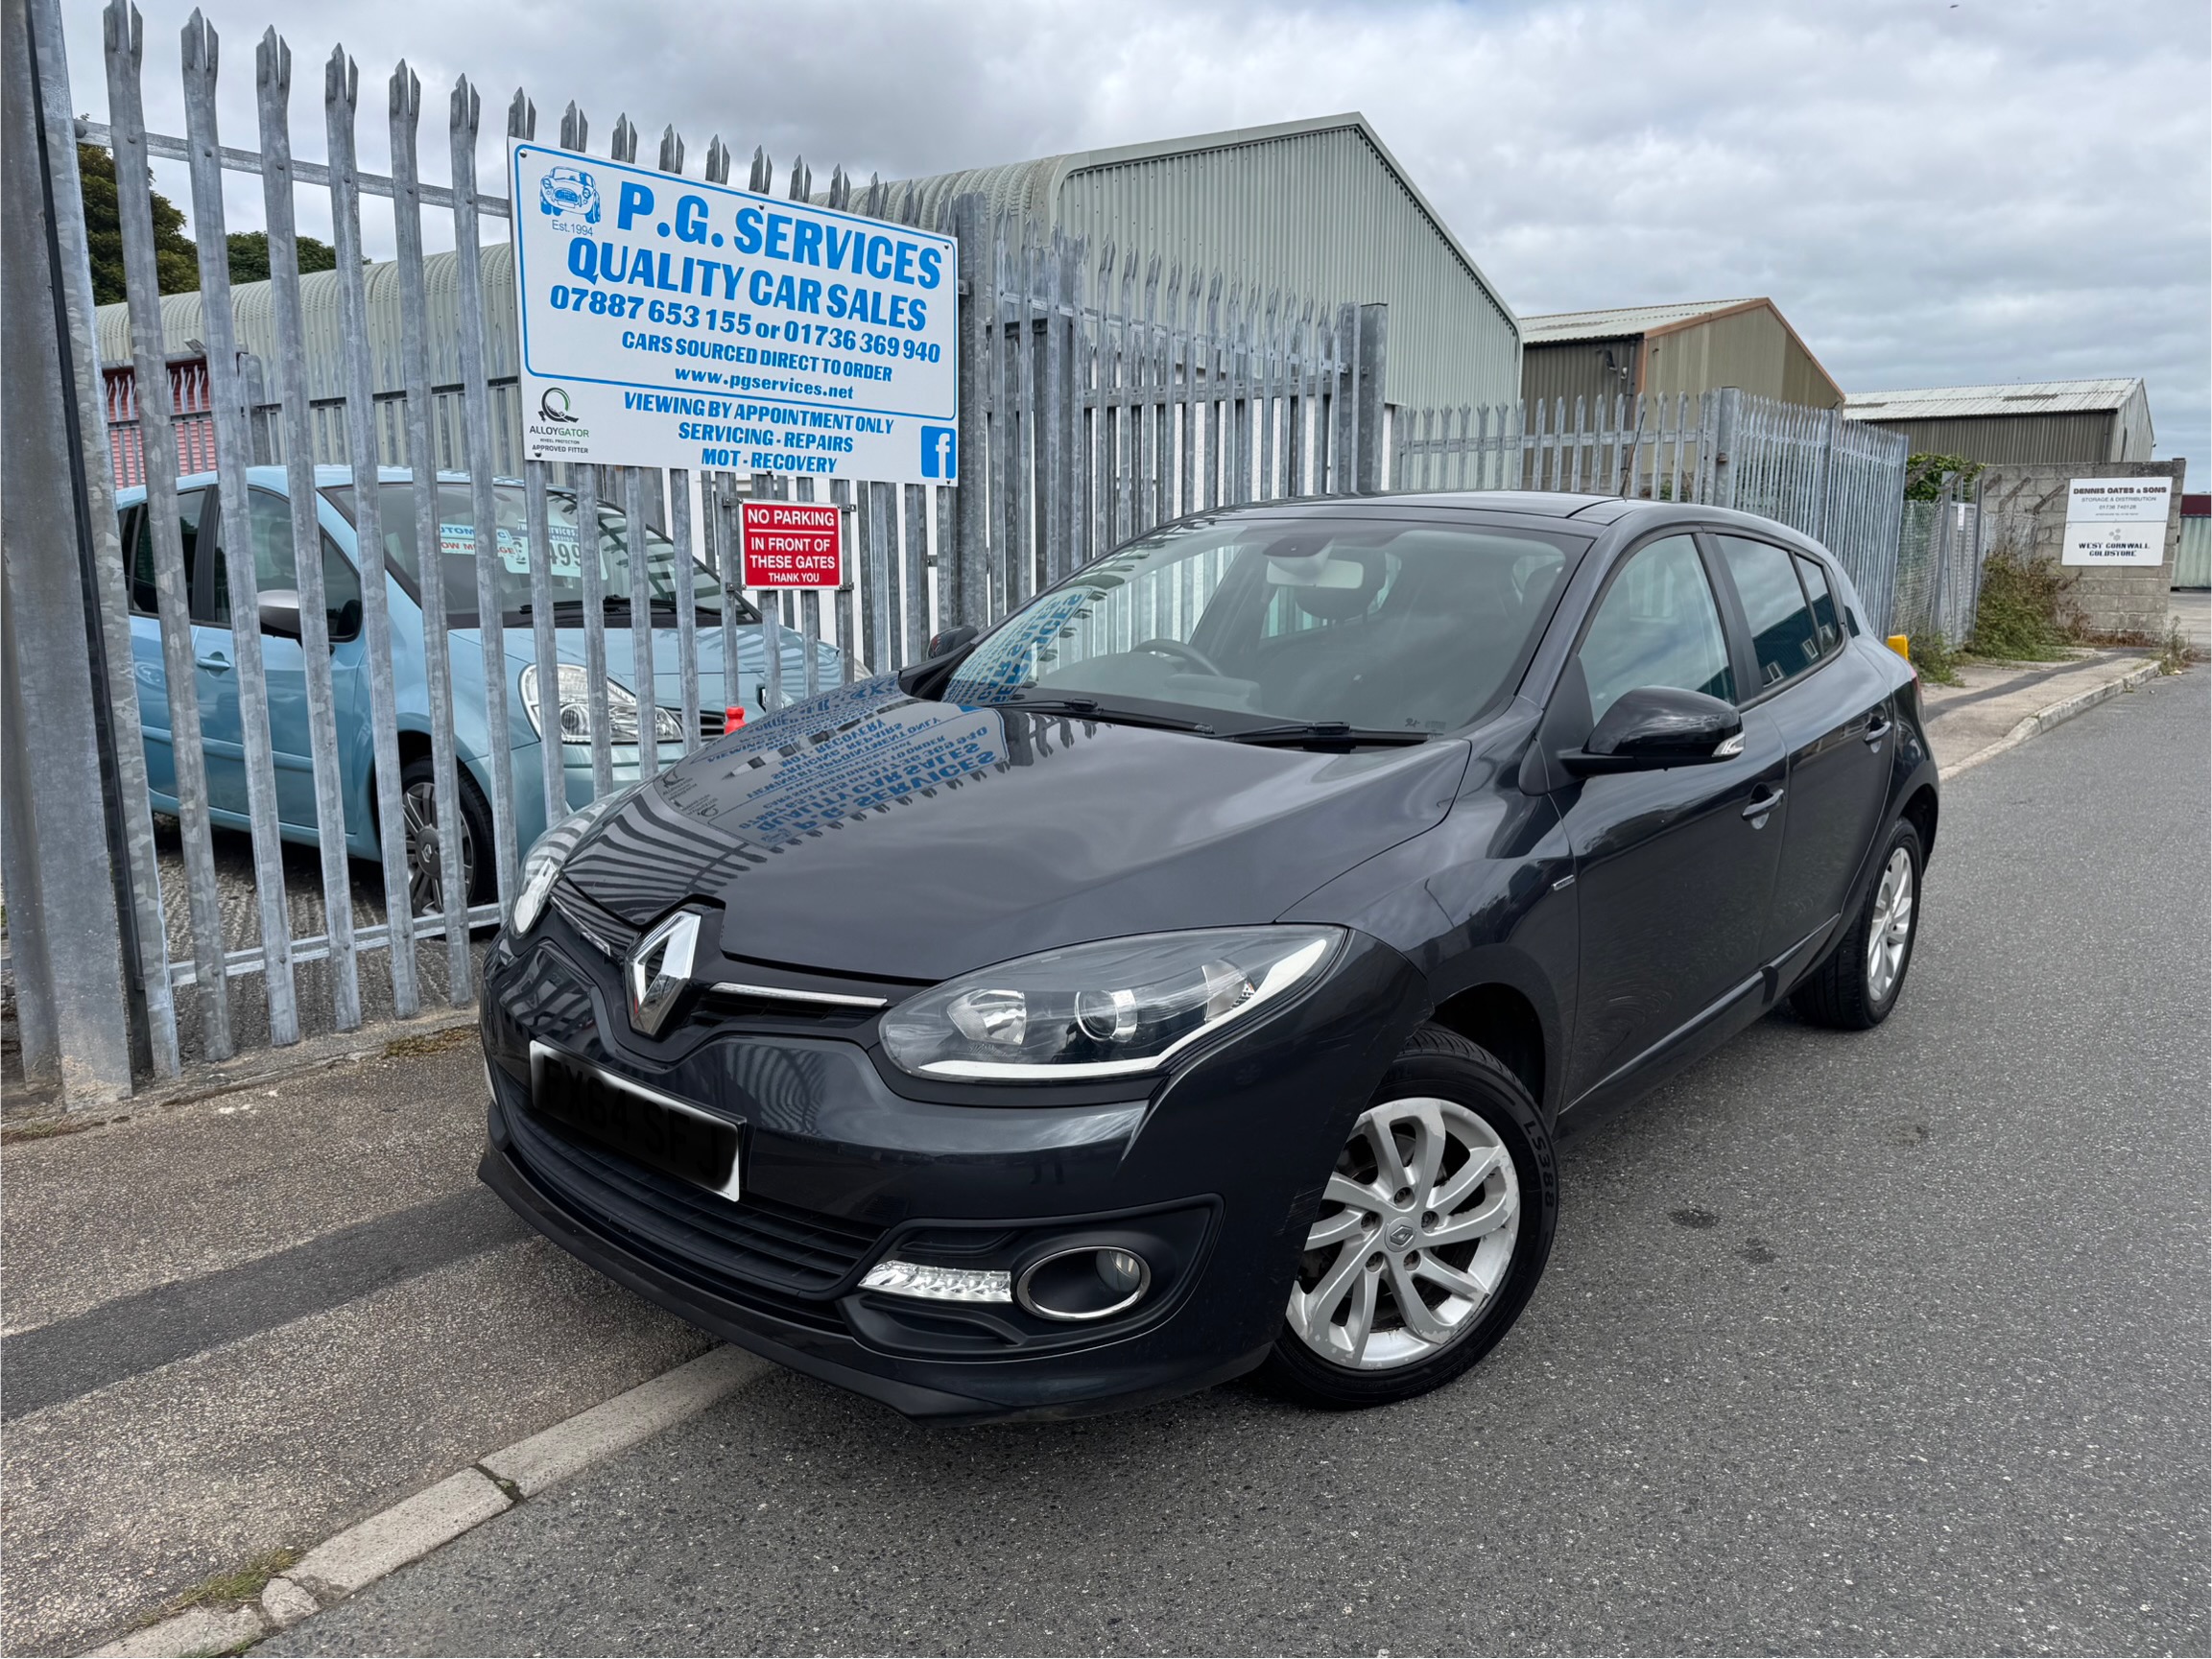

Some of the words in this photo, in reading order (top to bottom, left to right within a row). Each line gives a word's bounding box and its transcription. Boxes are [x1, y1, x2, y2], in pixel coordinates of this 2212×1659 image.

[552, 219, 594, 236] Est.1994
[617, 180, 724, 248] P.G.
[734, 207, 941, 289] SERVICES
[567, 237, 745, 301] QUALITY
[749, 270, 822, 315] CAR
[826, 283, 927, 332] SALES
[550, 284, 644, 320] 07887
[648, 299, 701, 328] 653
[705, 309, 751, 335] 155
[755, 321, 780, 340] or
[784, 320, 856, 350] 01736
[859, 332, 900, 357] 369
[903, 339, 940, 364] 940
[622, 331, 673, 353] CARS
[675, 337, 758, 365] SOURCED
[760, 350, 820, 371] DIRECT
[821, 358, 841, 375] TO
[843, 361, 892, 382] ORDER
[675, 367, 854, 399] www.pgservices.net
[624, 391, 705, 416] VIEWING
[708, 400, 732, 419] BY
[734, 403, 854, 431] APPOINTMENT
[855, 415, 894, 435] ONLY
[529, 425, 589, 438] ALLOYGATOR
[678, 422, 773, 446] SERVICING
[783, 431, 854, 453] REPAIRS
[532, 444, 566, 453] APPROVED
[702, 448, 741, 466] MOT
[750, 452, 837, 473] RECOVERY
[748, 509, 770, 524] NO
[773, 510, 835, 527] PARKING
[750, 537, 765, 551] IN
[768, 537, 811, 552] FRONT
[814, 538, 830, 552] OF
[749, 555, 793, 569] THESE
[796, 556, 836, 569] GATES
[768, 572, 799, 582] THANK
[801, 573, 820, 582] YOU
[1523, 1120, 1555, 1208] LS388
